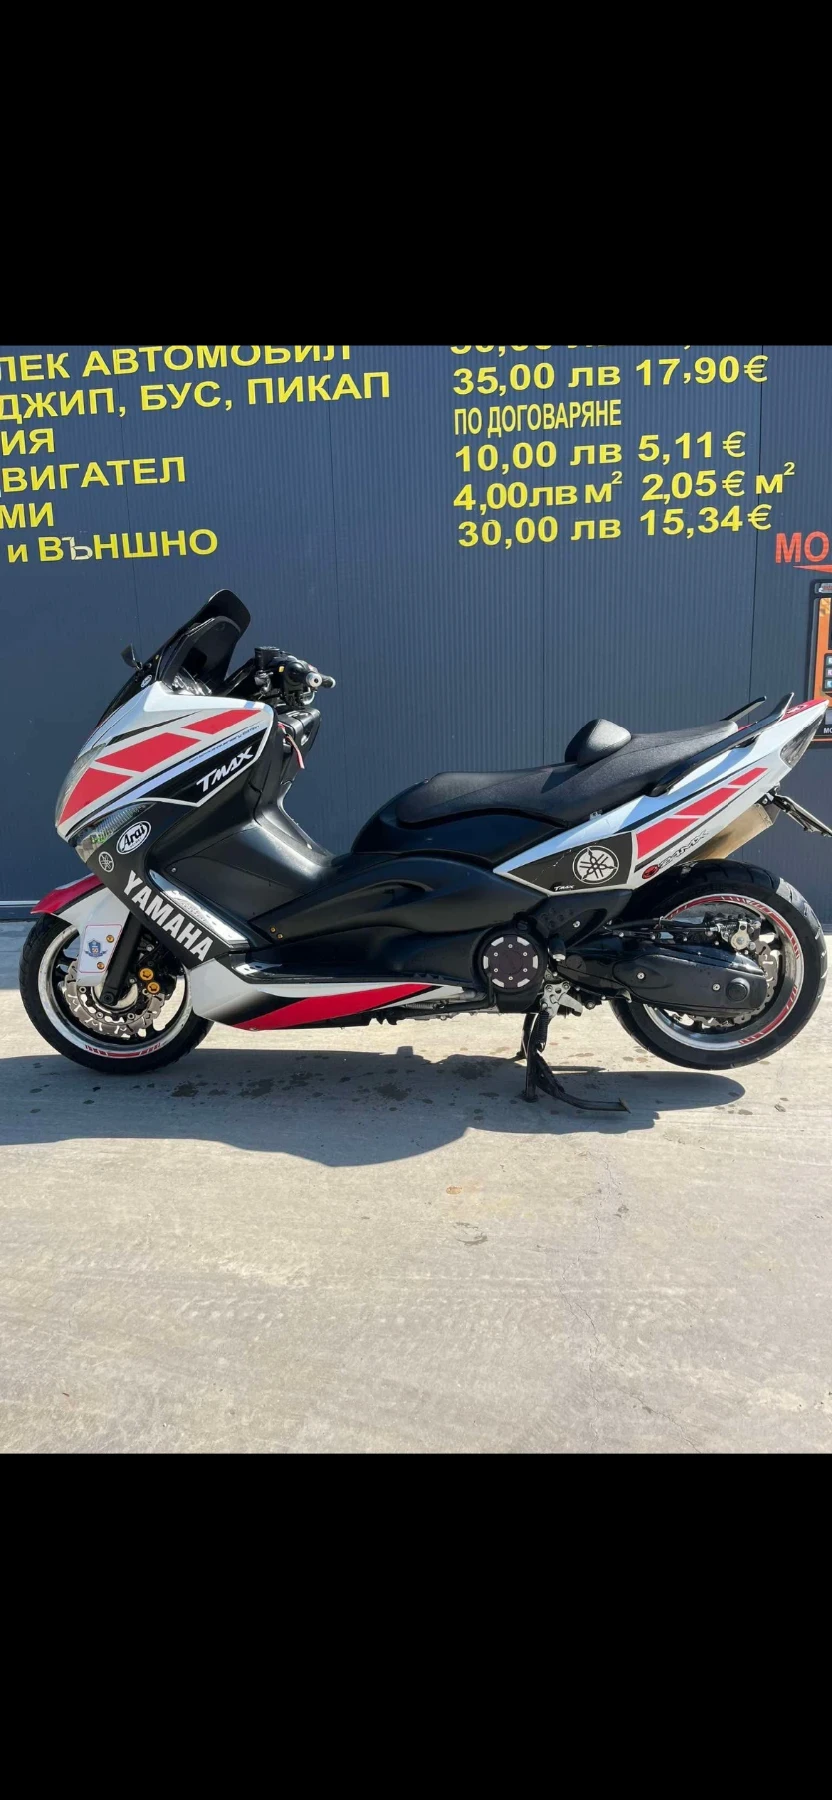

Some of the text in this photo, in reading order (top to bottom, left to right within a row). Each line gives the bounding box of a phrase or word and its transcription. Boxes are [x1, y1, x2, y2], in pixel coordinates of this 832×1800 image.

[0, 345, 351, 382] ЛЕК АВТОМОБИЛ
[453, 363, 555, 396] 35,00
[568, 366, 621, 388] лв
[0, 372, 390, 425] ДЖИП, БУС, ПИКАП
[454, 400, 622, 438] ПО ДОГОВАРЯНЕ
[1, 428, 55, 456] ИЯ
[455, 441, 557, 475] 10,00
[570, 444, 622, 466] лв
[0, 457, 186, 498] ВИГАТЕЛ
[0, 502, 55, 529] МИ
[458, 515, 559, 550] 30,00
[570, 519, 622, 541] лв
[7, 529, 219, 563] и ВЪНШНО
[196, 746, 254, 793] TMAX
[121, 824, 146, 853] Arai
[123, 869, 214, 962] YAMAHA
